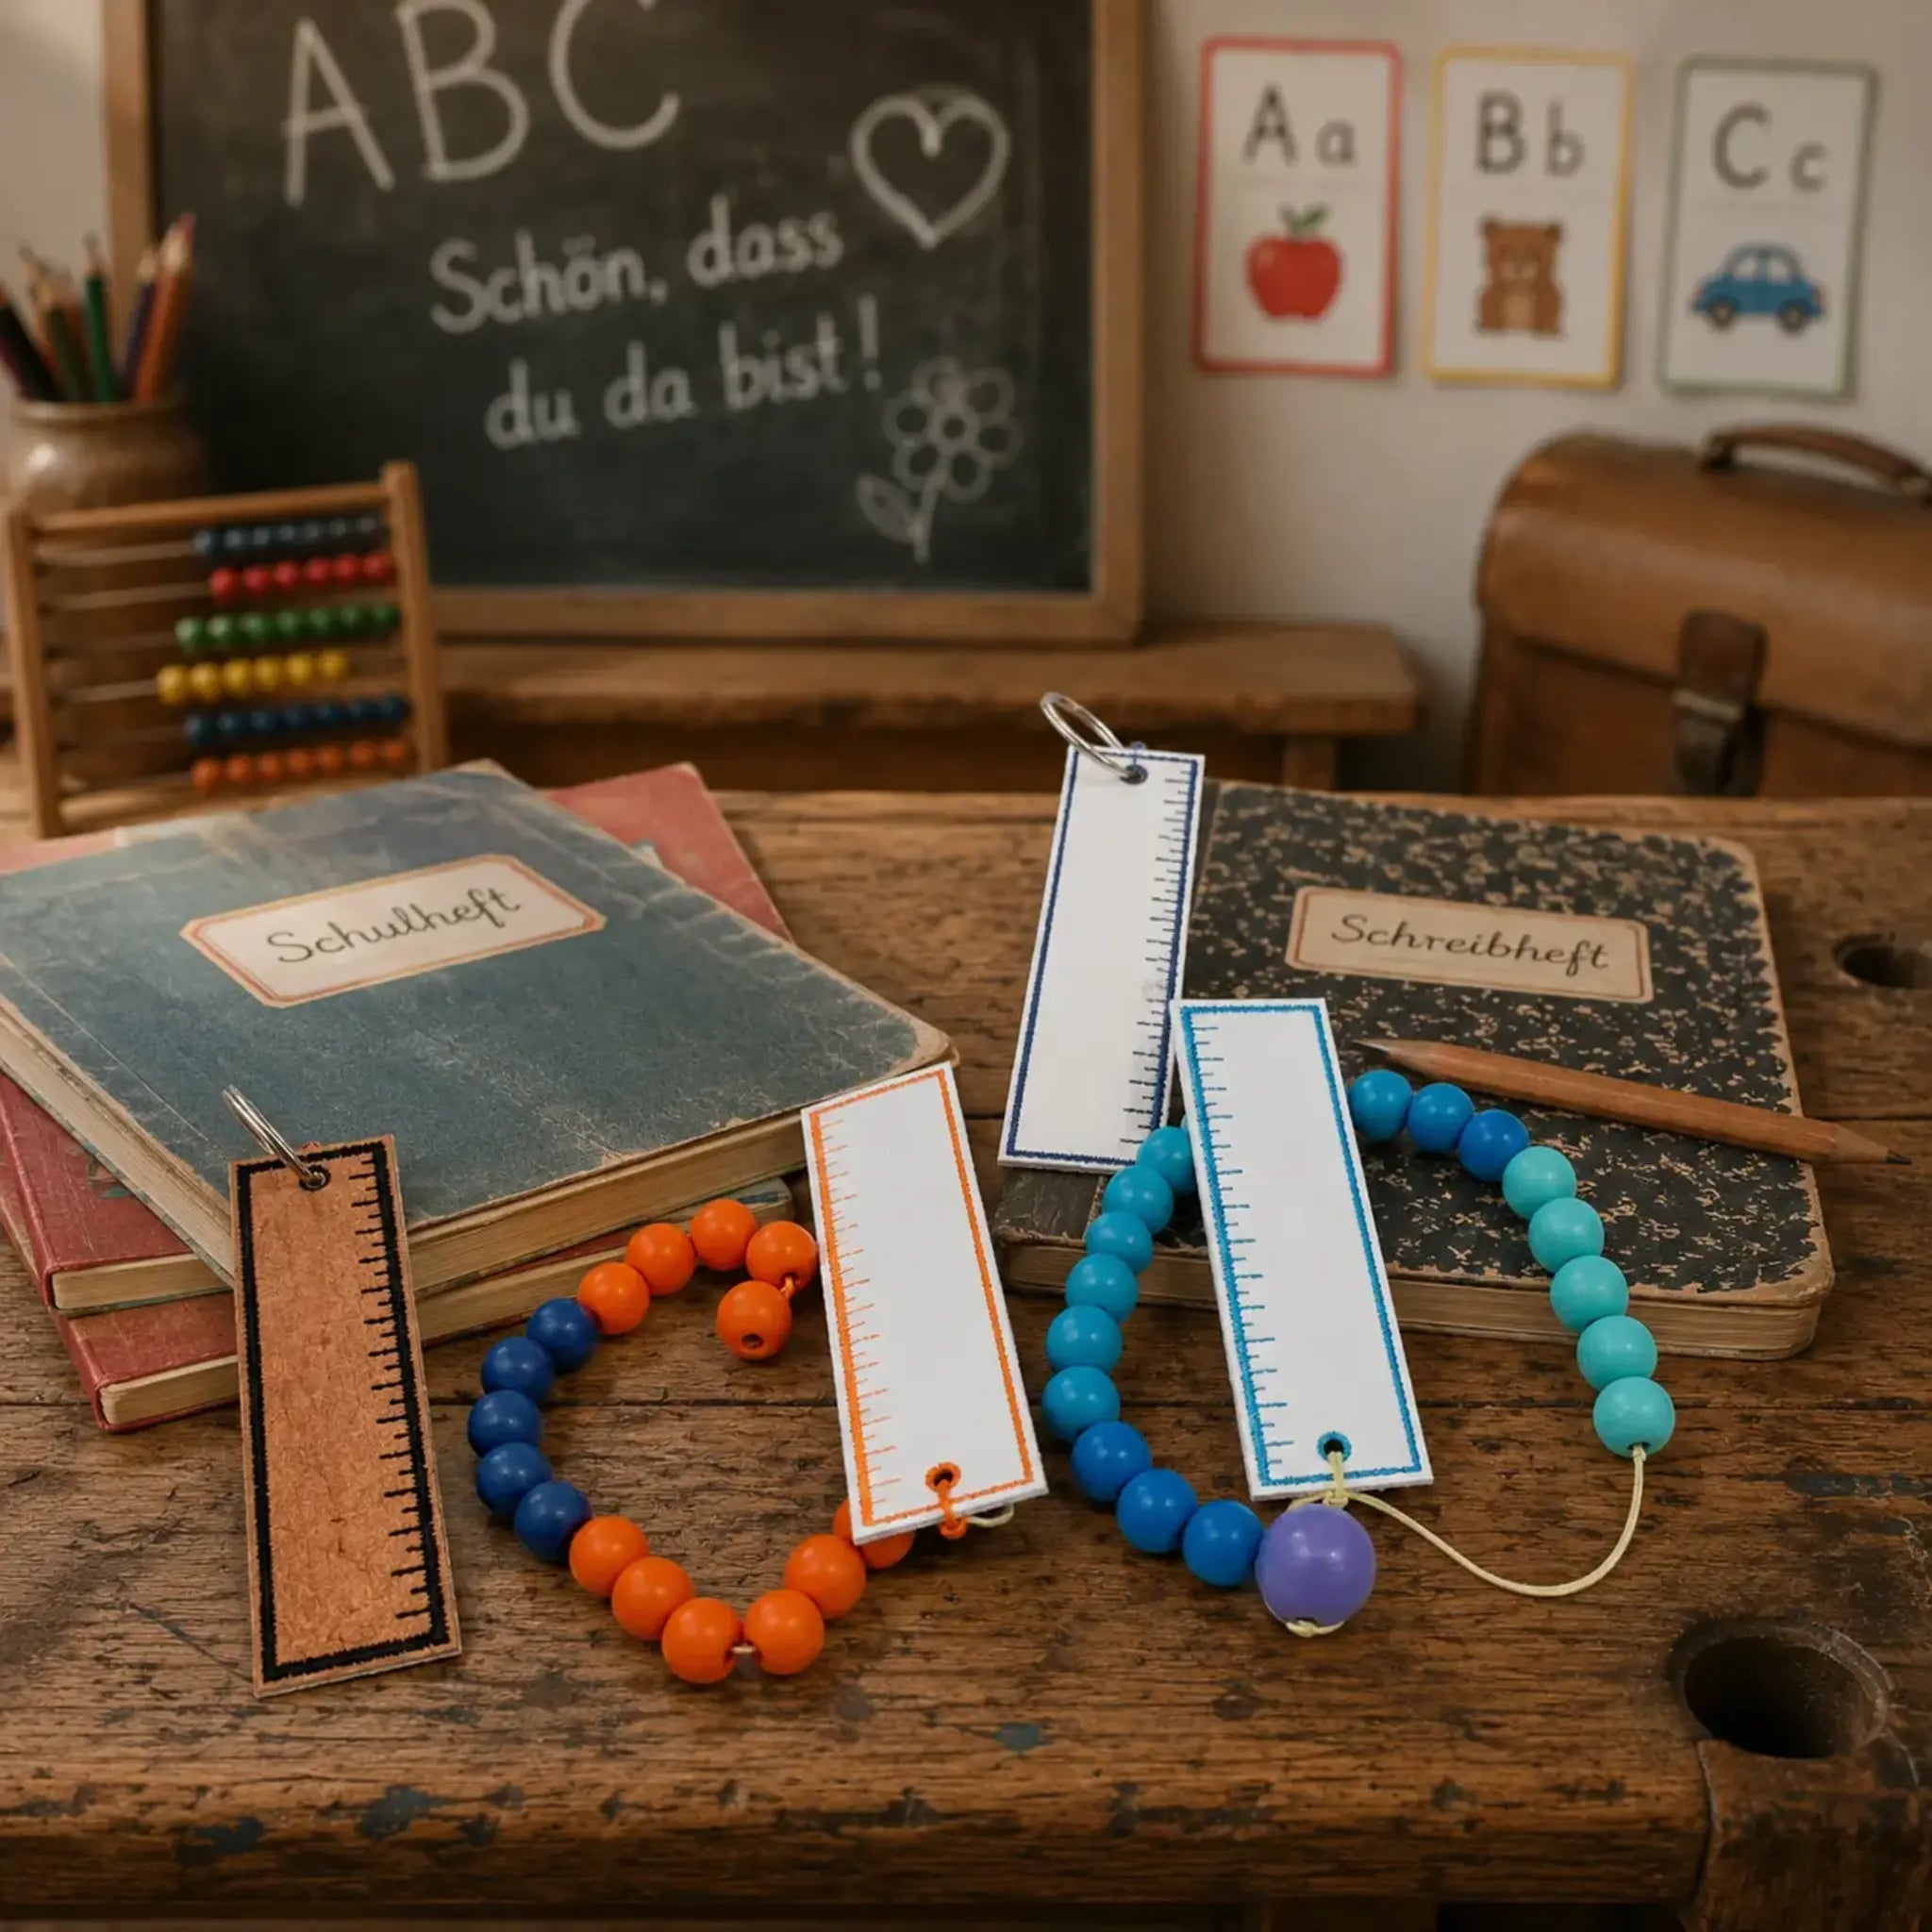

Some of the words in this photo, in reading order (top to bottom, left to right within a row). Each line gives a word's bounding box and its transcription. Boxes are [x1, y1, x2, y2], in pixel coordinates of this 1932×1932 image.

[281, 0, 679, 207] ABC
[428, 229, 668, 335] Schön,
[686, 195, 844, 289] dass
[484, 358, 578, 450] du
[604, 341, 696, 433] da
[266, 887, 521, 963] Schulheft
[1331, 914, 1609, 977] Schreibheft
